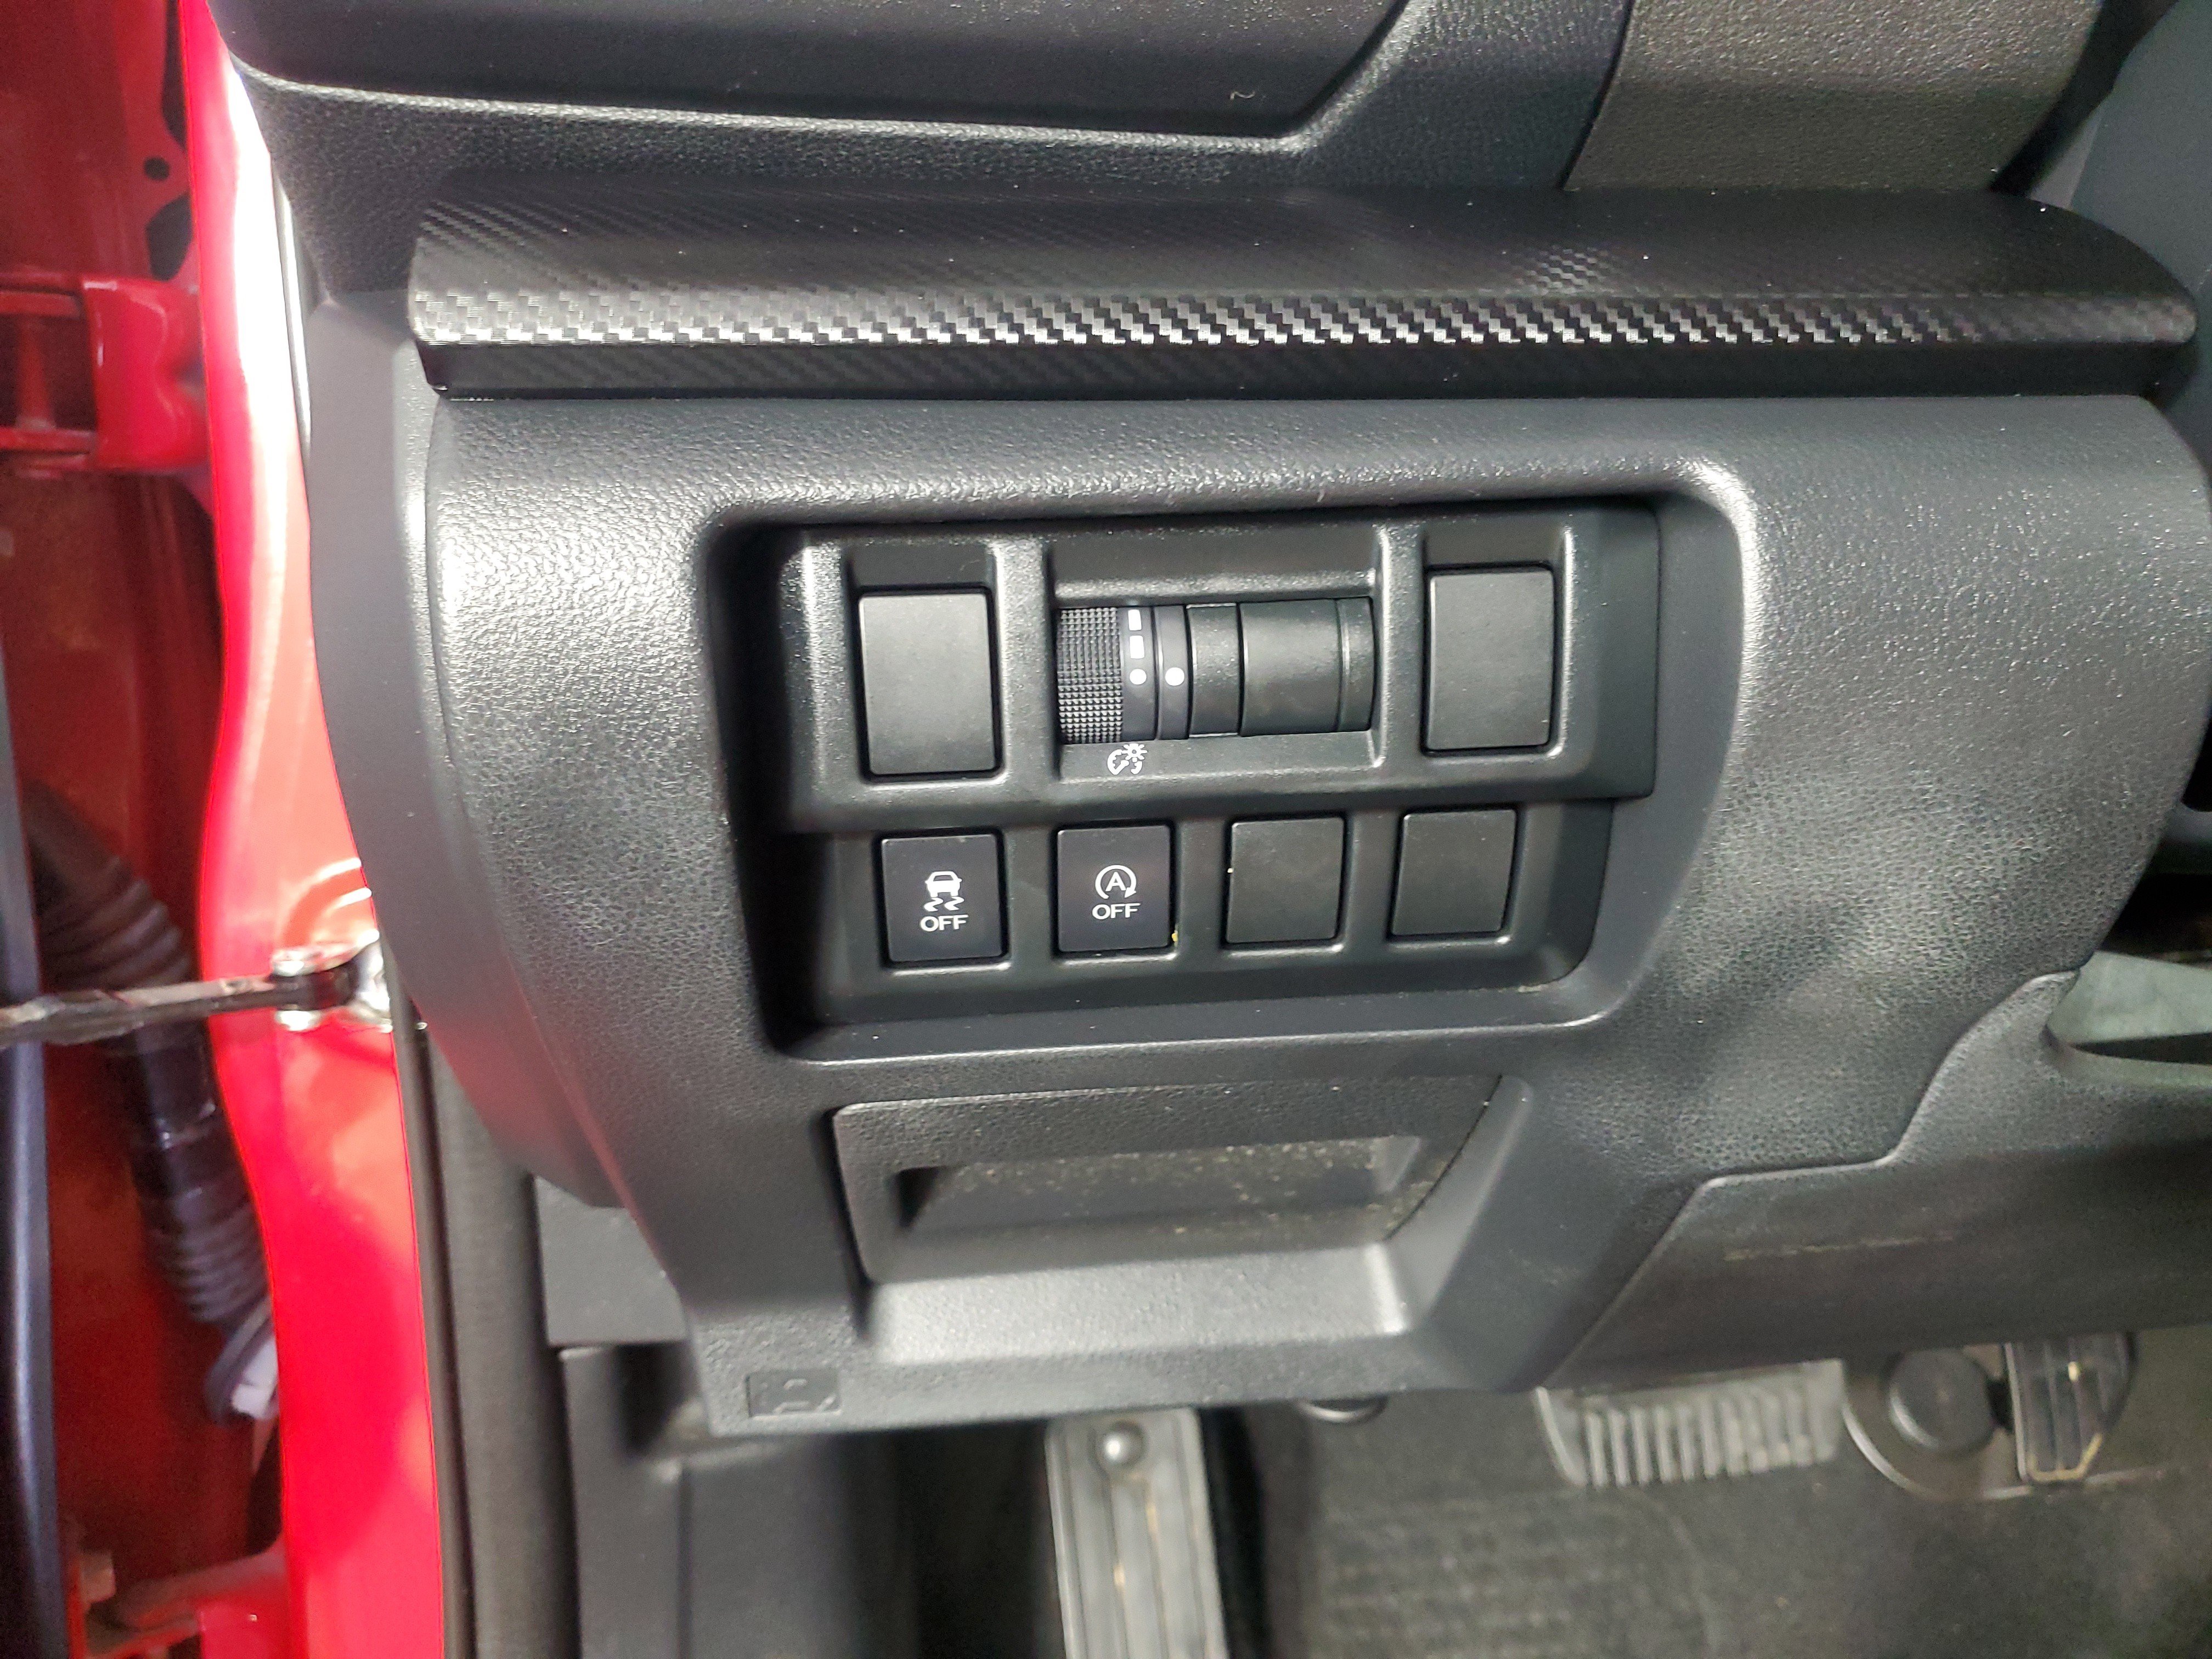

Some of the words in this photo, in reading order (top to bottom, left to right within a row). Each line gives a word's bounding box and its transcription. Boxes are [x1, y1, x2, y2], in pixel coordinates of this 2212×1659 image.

[1105, 872, 1126, 892] A
[1091, 902, 1141, 920] OFF
[919, 914, 969, 932] OFF
